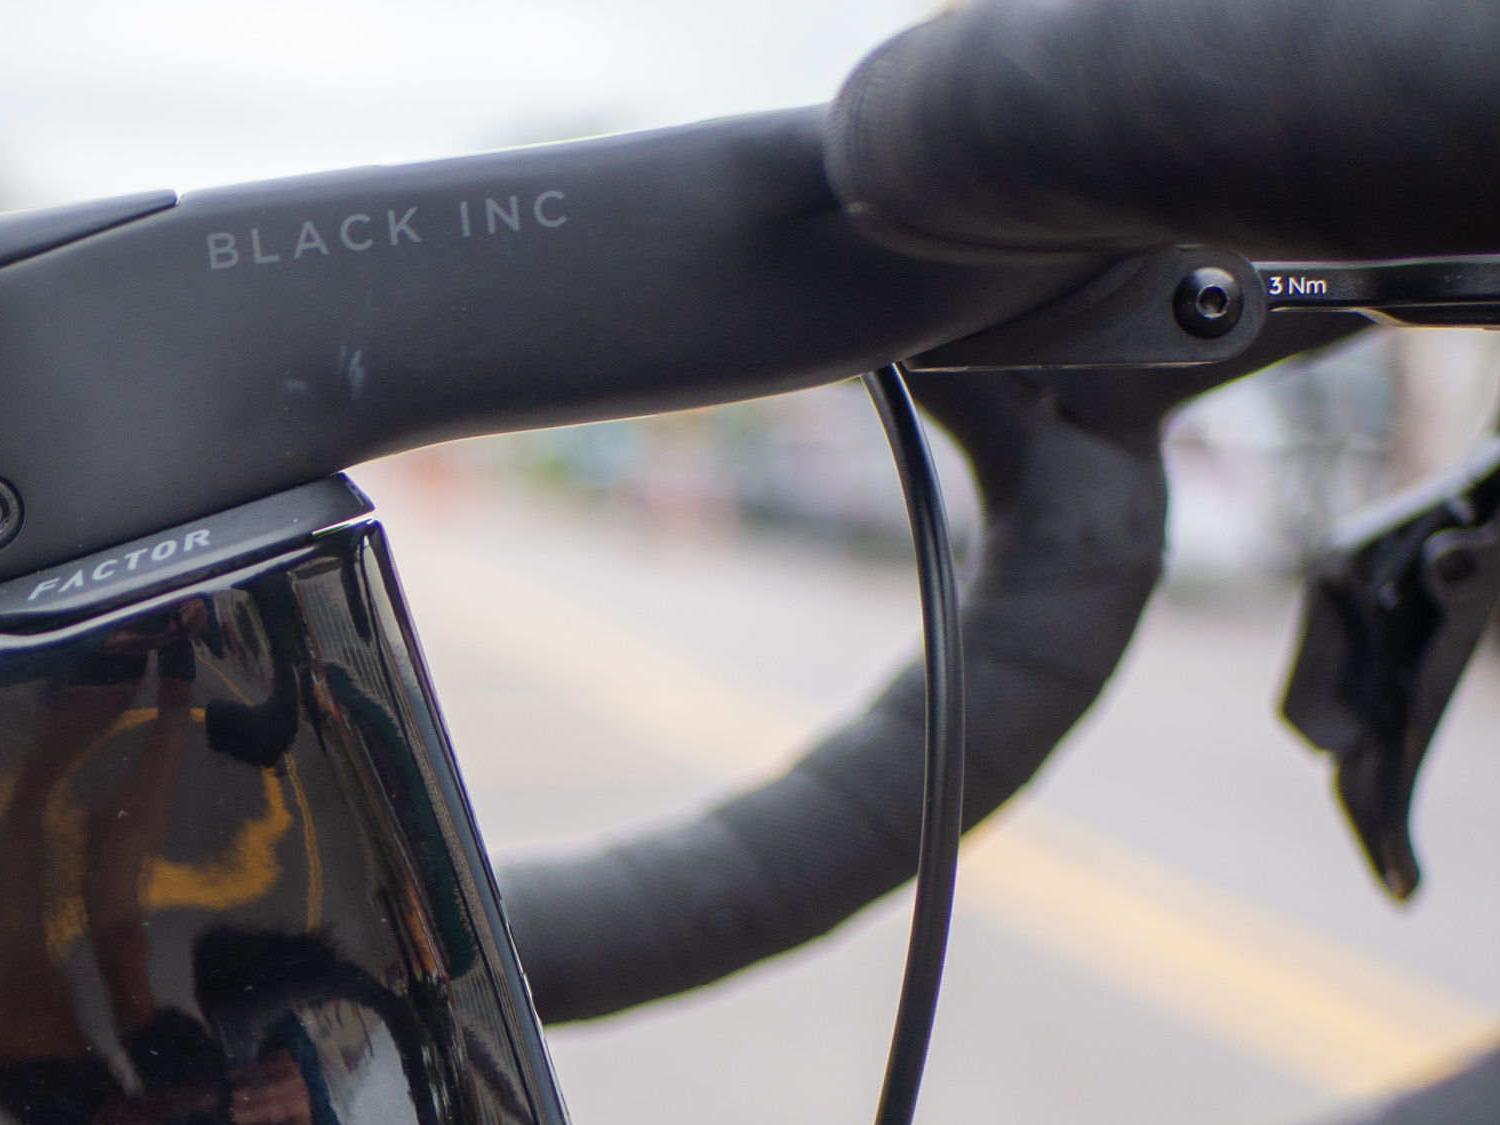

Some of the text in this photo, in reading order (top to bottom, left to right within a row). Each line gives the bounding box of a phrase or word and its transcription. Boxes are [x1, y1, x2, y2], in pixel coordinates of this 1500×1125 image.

[206, 189, 568, 270] BLACK INC
[1268, 276, 1327, 295] 3 Nm
[27, 528, 211, 601] FACTOR
